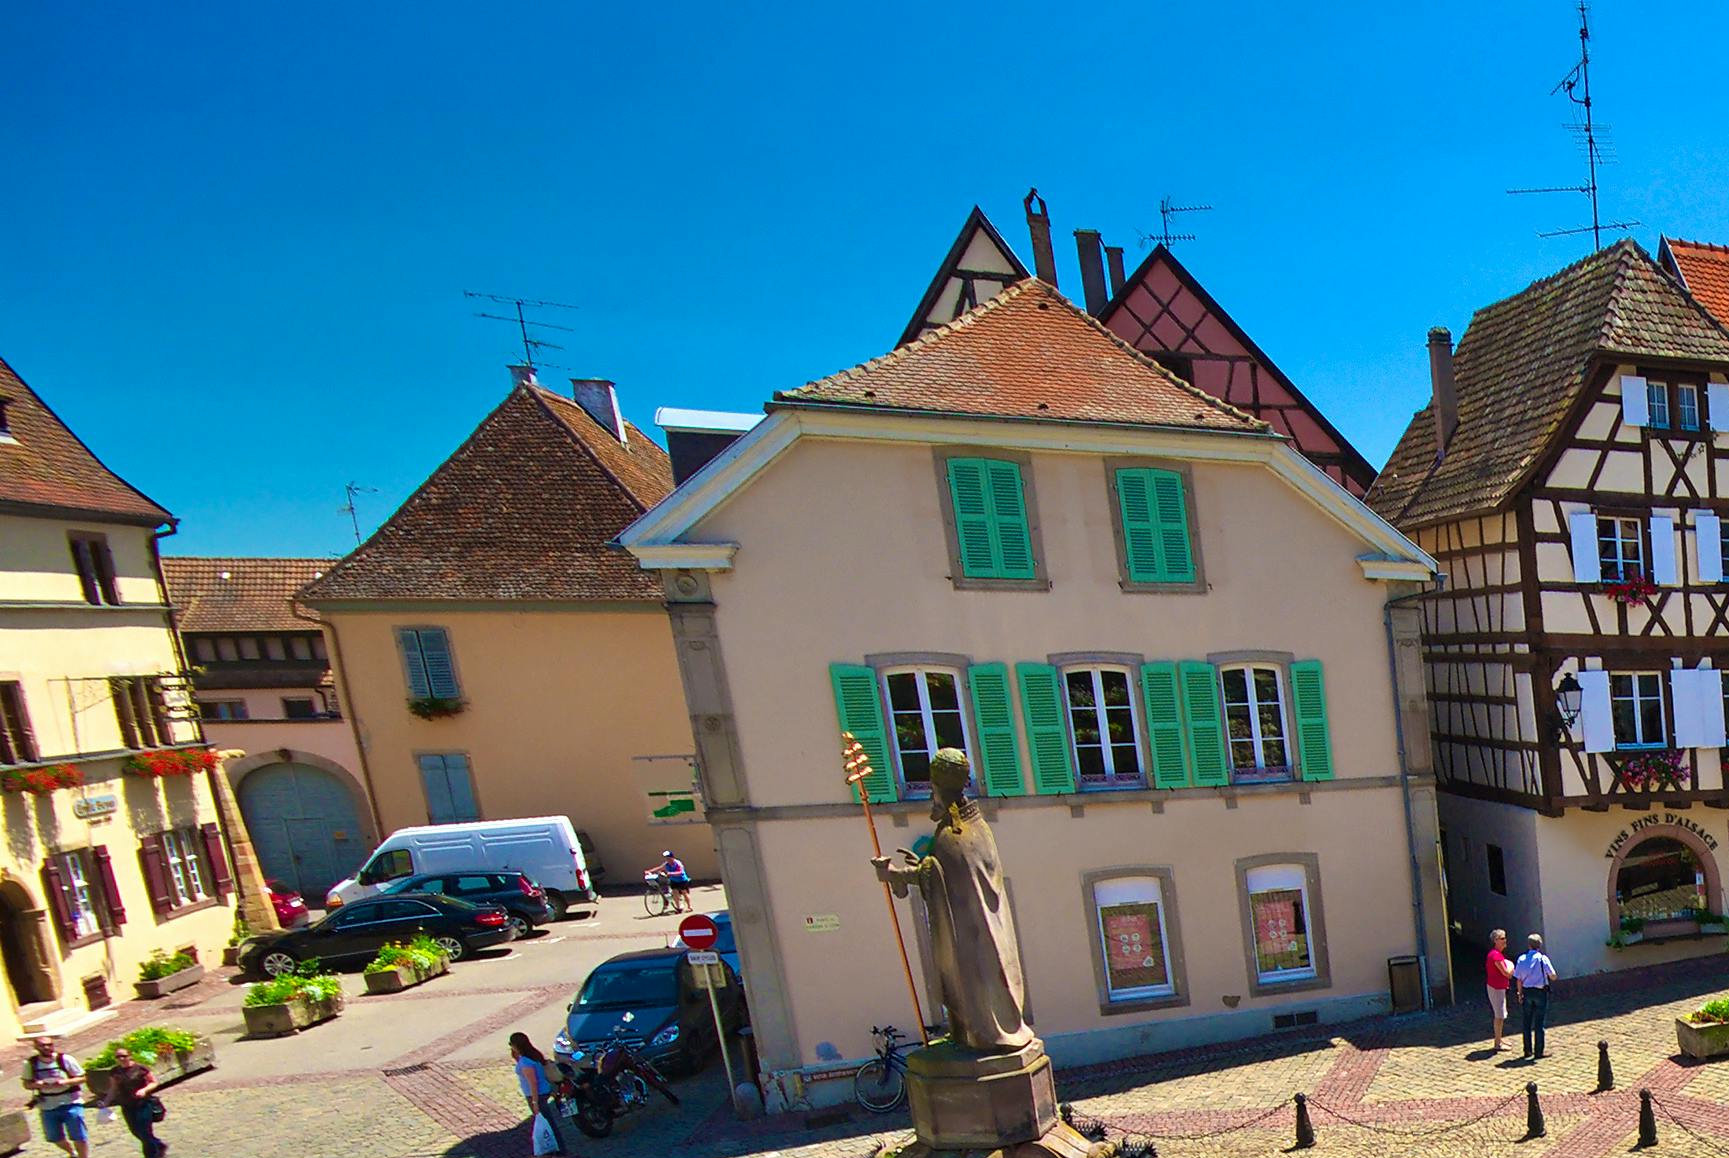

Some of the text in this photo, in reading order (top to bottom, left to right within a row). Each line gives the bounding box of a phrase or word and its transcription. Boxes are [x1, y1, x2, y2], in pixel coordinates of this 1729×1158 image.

[1605, 812, 1719, 858] VINS FINS D'ALSACE
